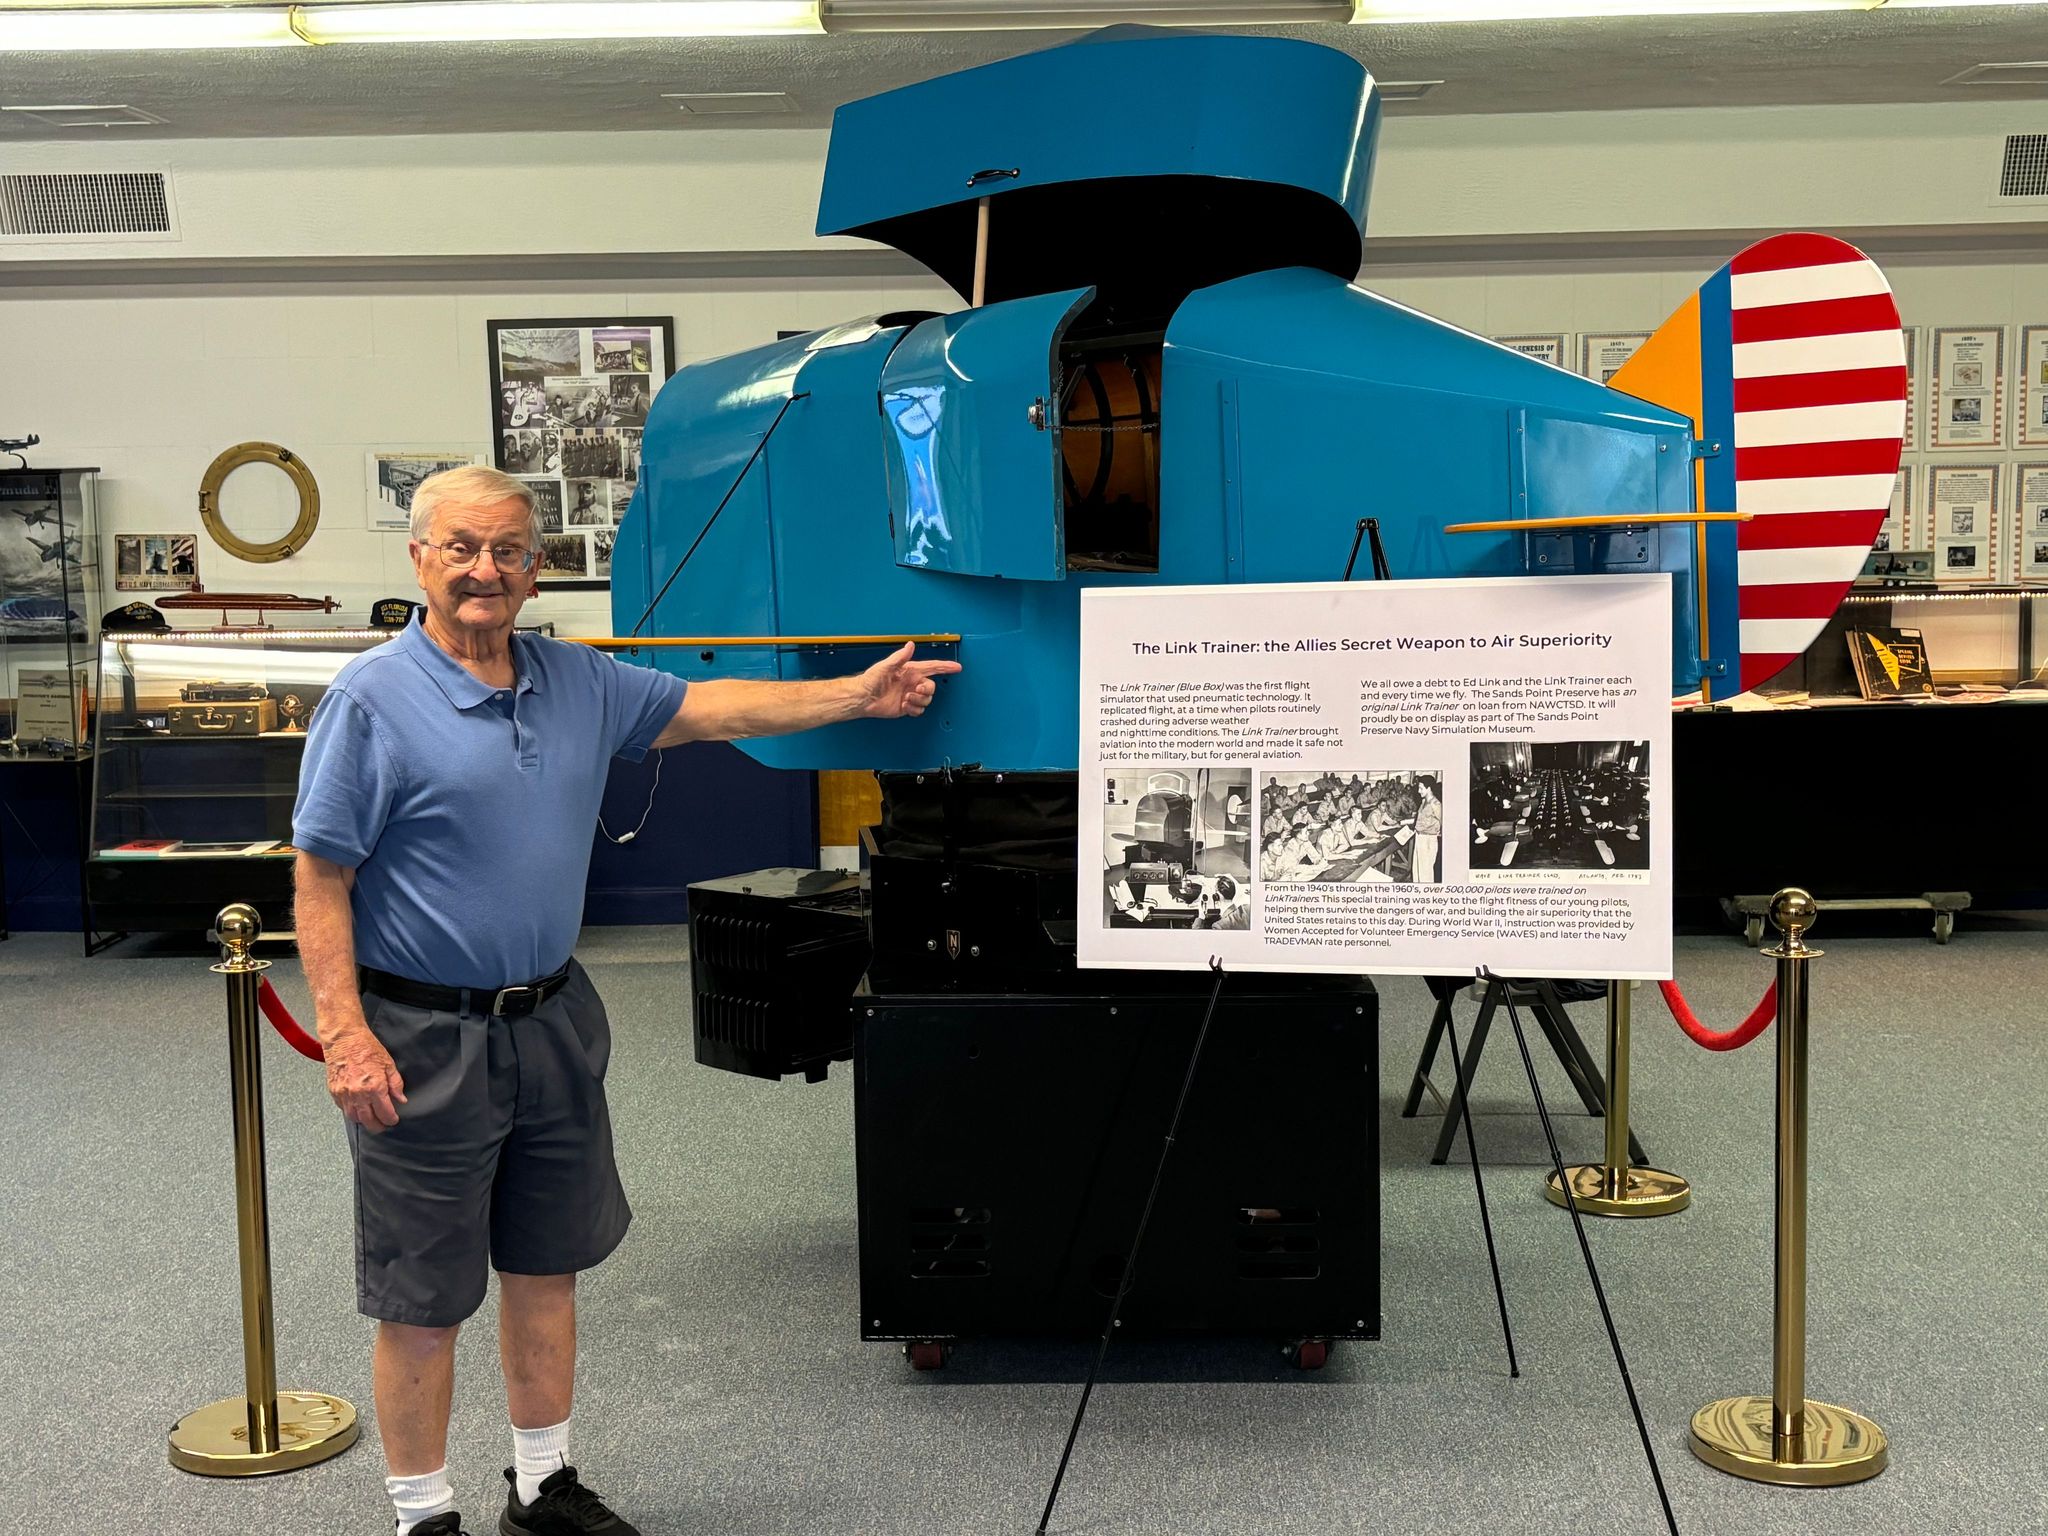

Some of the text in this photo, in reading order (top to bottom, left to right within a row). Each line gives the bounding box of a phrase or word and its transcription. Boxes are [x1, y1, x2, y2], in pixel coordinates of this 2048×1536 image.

[1132, 634, 1611, 655] The Link Trainer: the Allies Secret Weapon to Air Superiority
[1100, 680, 1310, 693] The Link Trainer (Blue Box) was the first flight
[1360, 679, 1377, 688] We
[1379, 679, 1390, 688] all
[1424, 678, 1447, 688] debt
[1450, 678, 1460, 687] to
[1463, 678, 1476, 687] Ed
[1479, 677, 1500, 687] Link
[1502, 677, 1522, 687] and
[1524, 677, 1542, 686] the
[1544, 676, 1566, 686] Link
[1568, 676, 1604, 686] Trainer
[1606, 676, 1631, 685] each
[1100, 691, 1310, 704] simulator that used pneumatic technology. It
[1360, 690, 1379, 700] and
[1382, 692, 1408, 702] every
[1410, 690, 1433, 699] time
[1452, 689, 1466, 701] fly.
[1471, 689, 1490, 698] The
[1492, 688, 1522, 698] Sands
[1526, 688, 1552, 698] Point
[1555, 687, 1599, 697] Preserve
[1602, 687, 1620, 697] has
[1361, 701, 1399, 713] original
[1400, 701, 1422, 711] Link
[1424, 701, 1459, 710] Trainer
[1478, 700, 1499, 710] loan
[1502, 700, 1526, 710] from
[1529, 699, 1585, 709] NAWCTSD.
[1588, 699, 1595, 709] It
[1598, 699, 1615, 709] will
[1100, 725, 1338, 739] and nighttime conditions. The Link Trainer brought
[1360, 724, 1535, 737] Preserve Navy Simulation Museum.
[1098, 749, 1302, 762] just for the military, but for general aviation.
[1264, 883, 1288, 892] From
[1290, 883, 1305, 892] the
[1307, 883, 1334, 892] 1940's
[1336, 884, 1372, 895] through
[1374, 884, 1390, 893] the
[1392, 884, 1420, 895] 1960's,
[1444, 885, 1484, 896] 500,000
[1484, 885, 1511, 896] pilots
[1538, 885, 1573, 895] trained
[1321, 894, 1340, 903] This
[1341, 895, 1372, 906] special
[1374, 895, 1410, 906] training
[1432, 896, 1448, 906] key
[1450, 896, 1459, 905] to
[1462, 896, 1477, 905] the
[1479, 896, 1504, 907] flight
[1506, 896, 1537, 906] fitness
[1538, 897, 1548, 906] of
[1568, 899, 1598, 908] young
[1601, 897, 1629, 908] pilots,
[1264, 915, 1294, 924] United
[1296, 915, 1324, 924] States
[1326, 916, 1356, 925] retains
[1358, 916, 1367, 925] to
[1369, 916, 1386, 925] this
[1388, 916, 1406, 927] day.
[1408, 917, 1440, 928] During
[1442, 917, 1470, 926] World
[1472, 918, 1492, 926] War
[1504, 918, 1555, 927] instruction
[1578, 919, 1620, 930] provided
[1622, 919, 1634, 930] by
[1264, 926, 1626, 941] Women Accepted for Volunteer Emergency Service (WAVES) and later the Navy
[1264, 936, 1391, 949] TRADEVMAN rate personnel.
